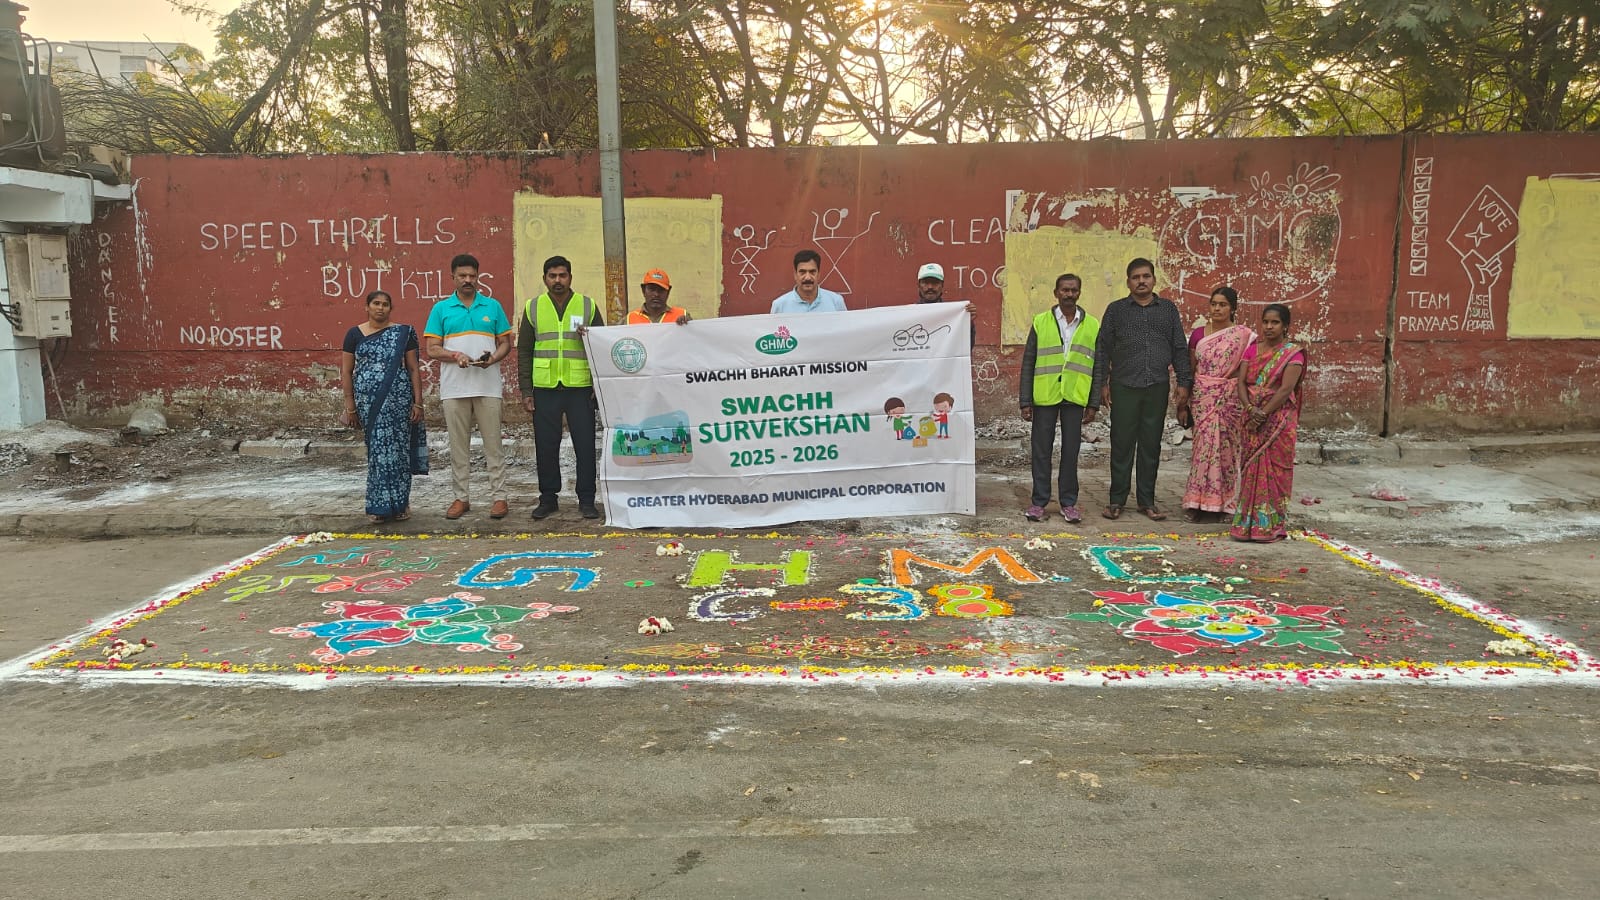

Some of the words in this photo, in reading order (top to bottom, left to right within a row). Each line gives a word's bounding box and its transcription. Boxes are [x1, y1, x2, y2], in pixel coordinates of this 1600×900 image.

[1478, 194, 1512, 233] VOTE
[201, 221, 298, 250] SPEED
[307, 215, 457, 247] THRILLS
[1184, 209, 1313, 268] GHMC
[98, 232, 120, 343] DANGER
[322, 266, 388, 299] BUT
[400, 268, 495, 300] KILS
[1407, 291, 1450, 310] TEAM
[1469, 307, 1489, 318] YOUR
[1471, 294, 1489, 307] USE
[1399, 315, 1459, 332] PRAYAAS
[1466, 319, 1493, 332] POWER
[210, 325, 284, 350] POSTER
[759, 337, 795, 351] GHMC
[685, 369, 747, 384] SWACHH
[751, 364, 806, 379] BHARAT
[809, 360, 868, 376] MISSION
[721, 390, 834, 416] SWACHH
[699, 412, 871, 444] SURVEKSHAN
[729, 447, 775, 468] 2025
[792, 444, 839, 463] 2026
[627, 494, 686, 508] GREATER
[688, 491, 769, 506] HYDERABAD
[772, 486, 846, 503] MUNICIPAL
[848, 481, 946, 498] CORPORATION
